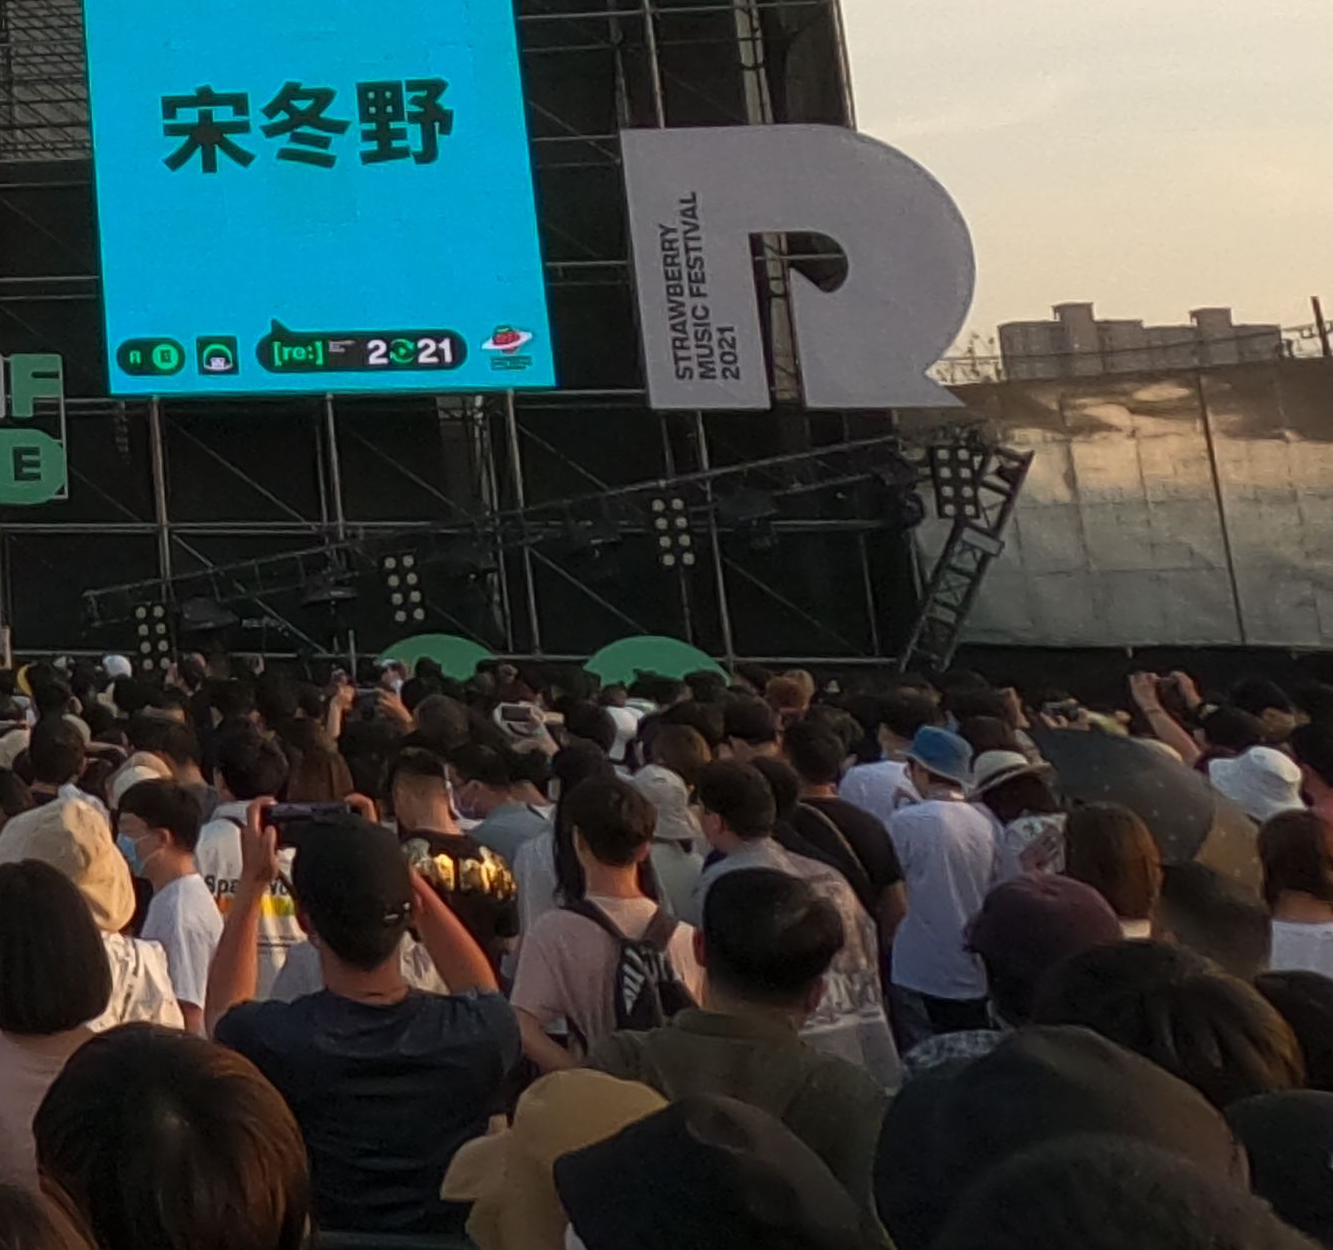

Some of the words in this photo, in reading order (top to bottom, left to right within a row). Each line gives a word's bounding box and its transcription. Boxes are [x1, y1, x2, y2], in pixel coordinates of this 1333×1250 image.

[161, 78, 454, 174] 宋冬野
[679, 192, 708, 298] FESTIVAL
[658, 223, 692, 381] STRAWBERRY
[689, 305, 718, 381] MUSIC
[721, 325, 741, 381] 2021
